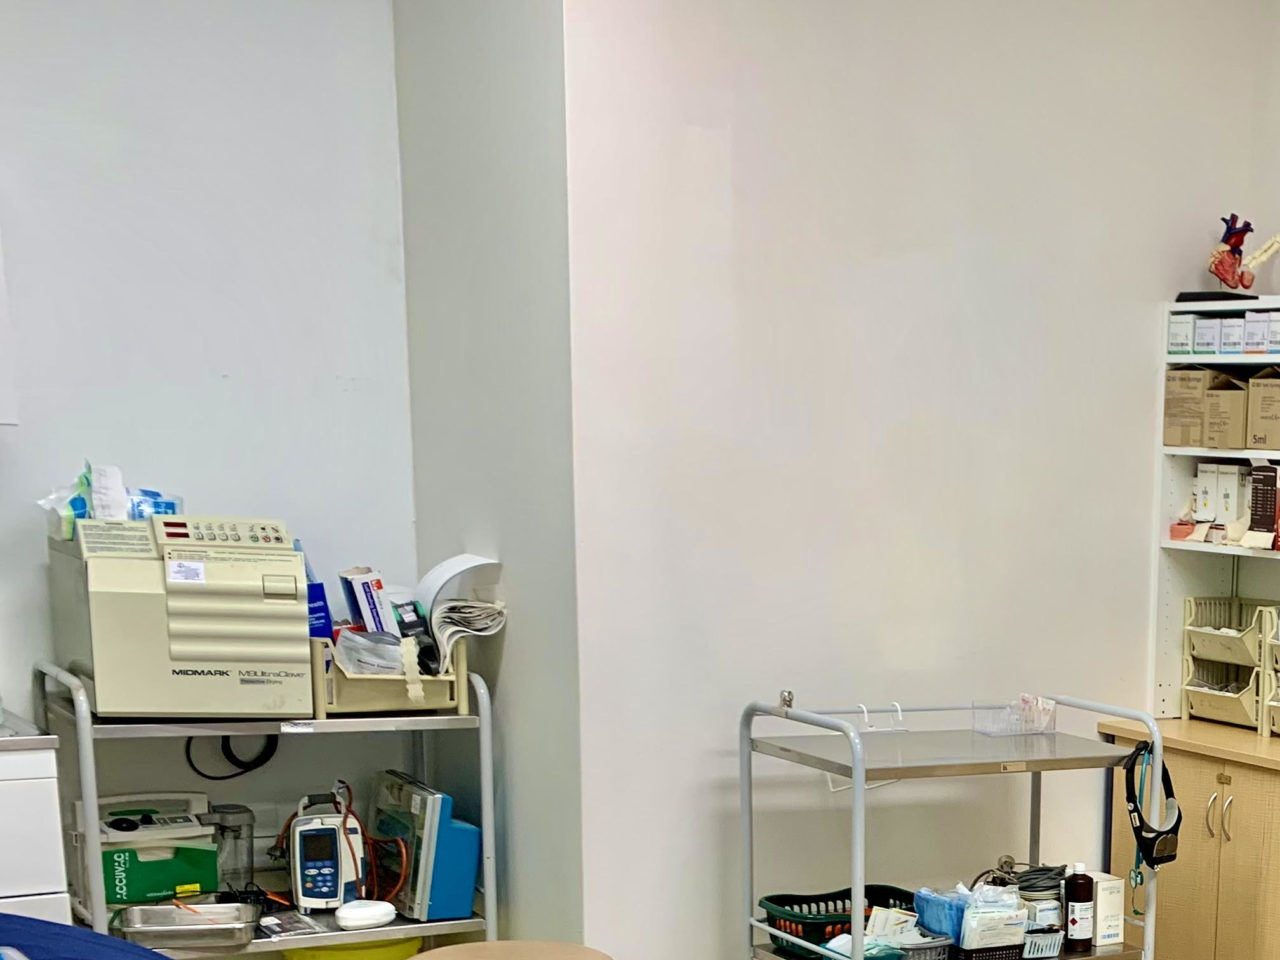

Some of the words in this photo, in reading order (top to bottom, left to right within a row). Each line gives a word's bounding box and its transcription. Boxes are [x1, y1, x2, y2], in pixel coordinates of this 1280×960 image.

[1252, 433, 1267, 445] 5ml
[171, 669, 231, 677] MIDMARK
[113, 852, 128, 900] ACCUVAC
